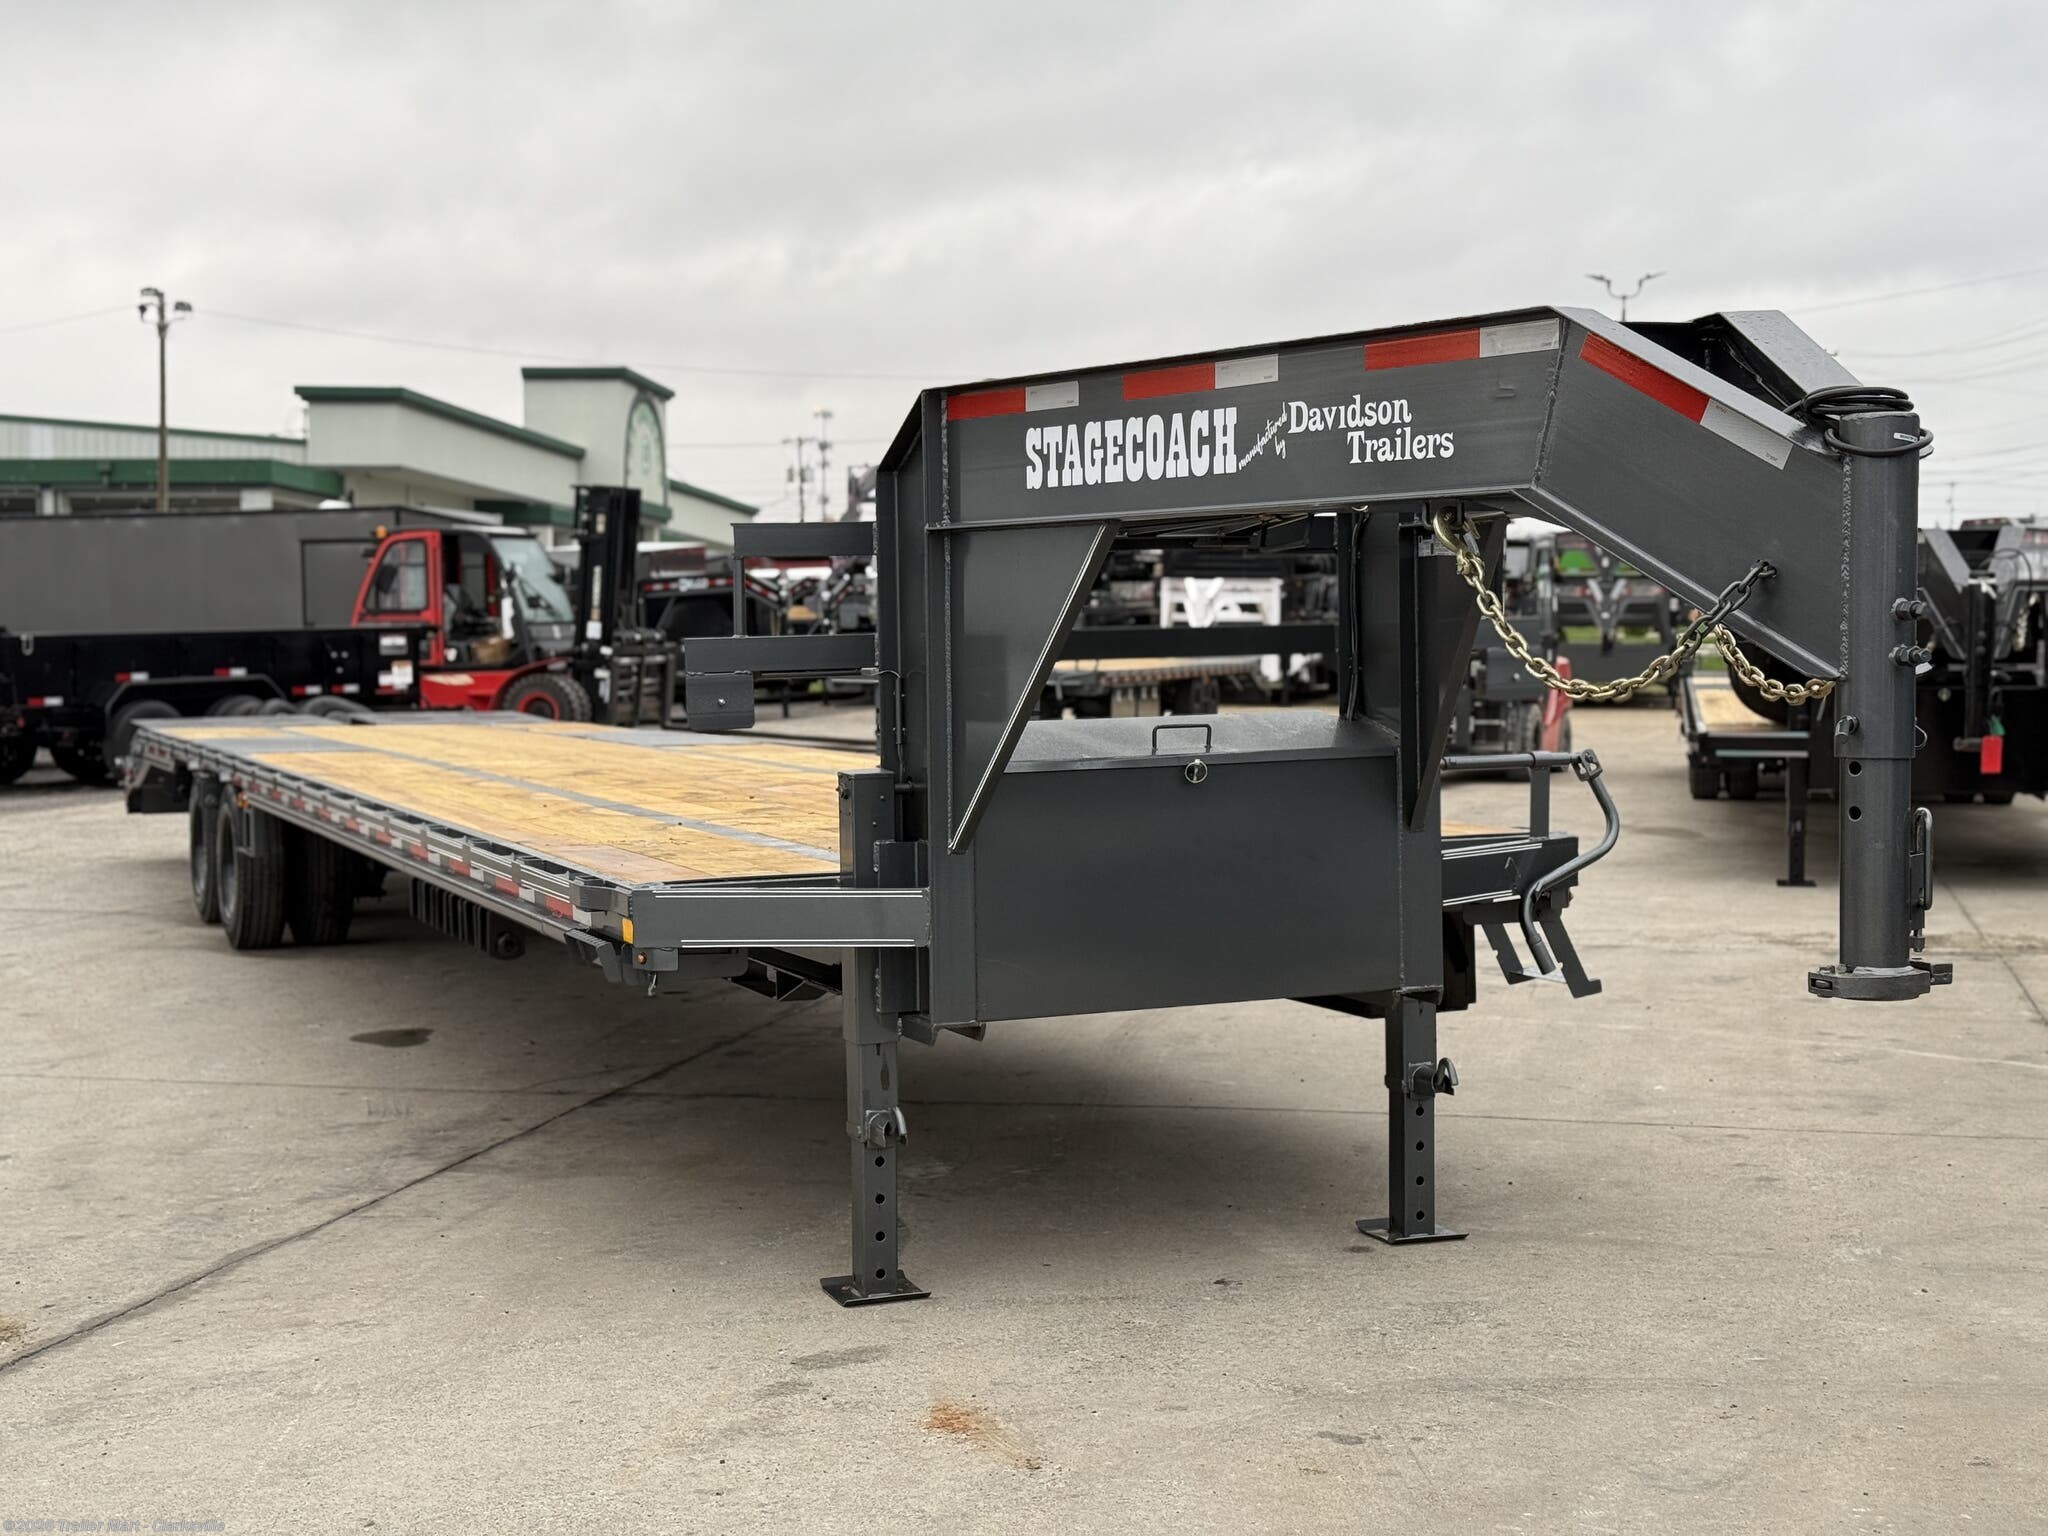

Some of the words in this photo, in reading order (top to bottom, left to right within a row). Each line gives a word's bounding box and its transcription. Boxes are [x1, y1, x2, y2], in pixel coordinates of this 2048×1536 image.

[1287, 394, 1412, 433] Davidson
[1025, 406, 1237, 490] STAGECOACH
[1239, 401, 1287, 470] manufactured
[1274, 435, 1286, 459] by
[1346, 427, 1454, 464] Trailers
